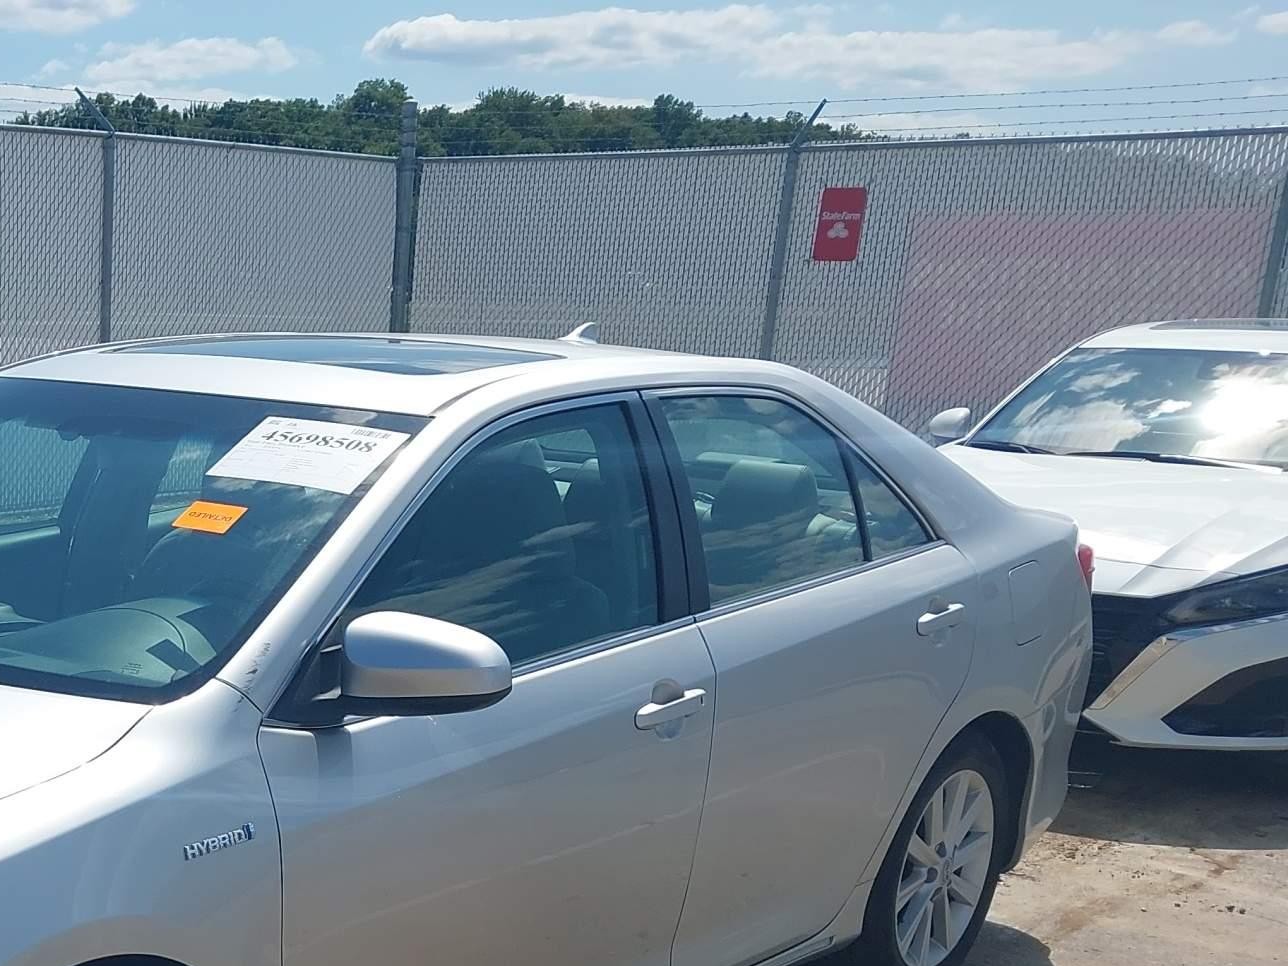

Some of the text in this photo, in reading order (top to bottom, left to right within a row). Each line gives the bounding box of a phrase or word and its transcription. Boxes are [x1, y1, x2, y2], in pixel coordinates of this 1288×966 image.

[262, 430, 377, 453] 45698508
[188, 511, 233, 522] DETAILED
[183, 828, 246, 861] HYBRID
